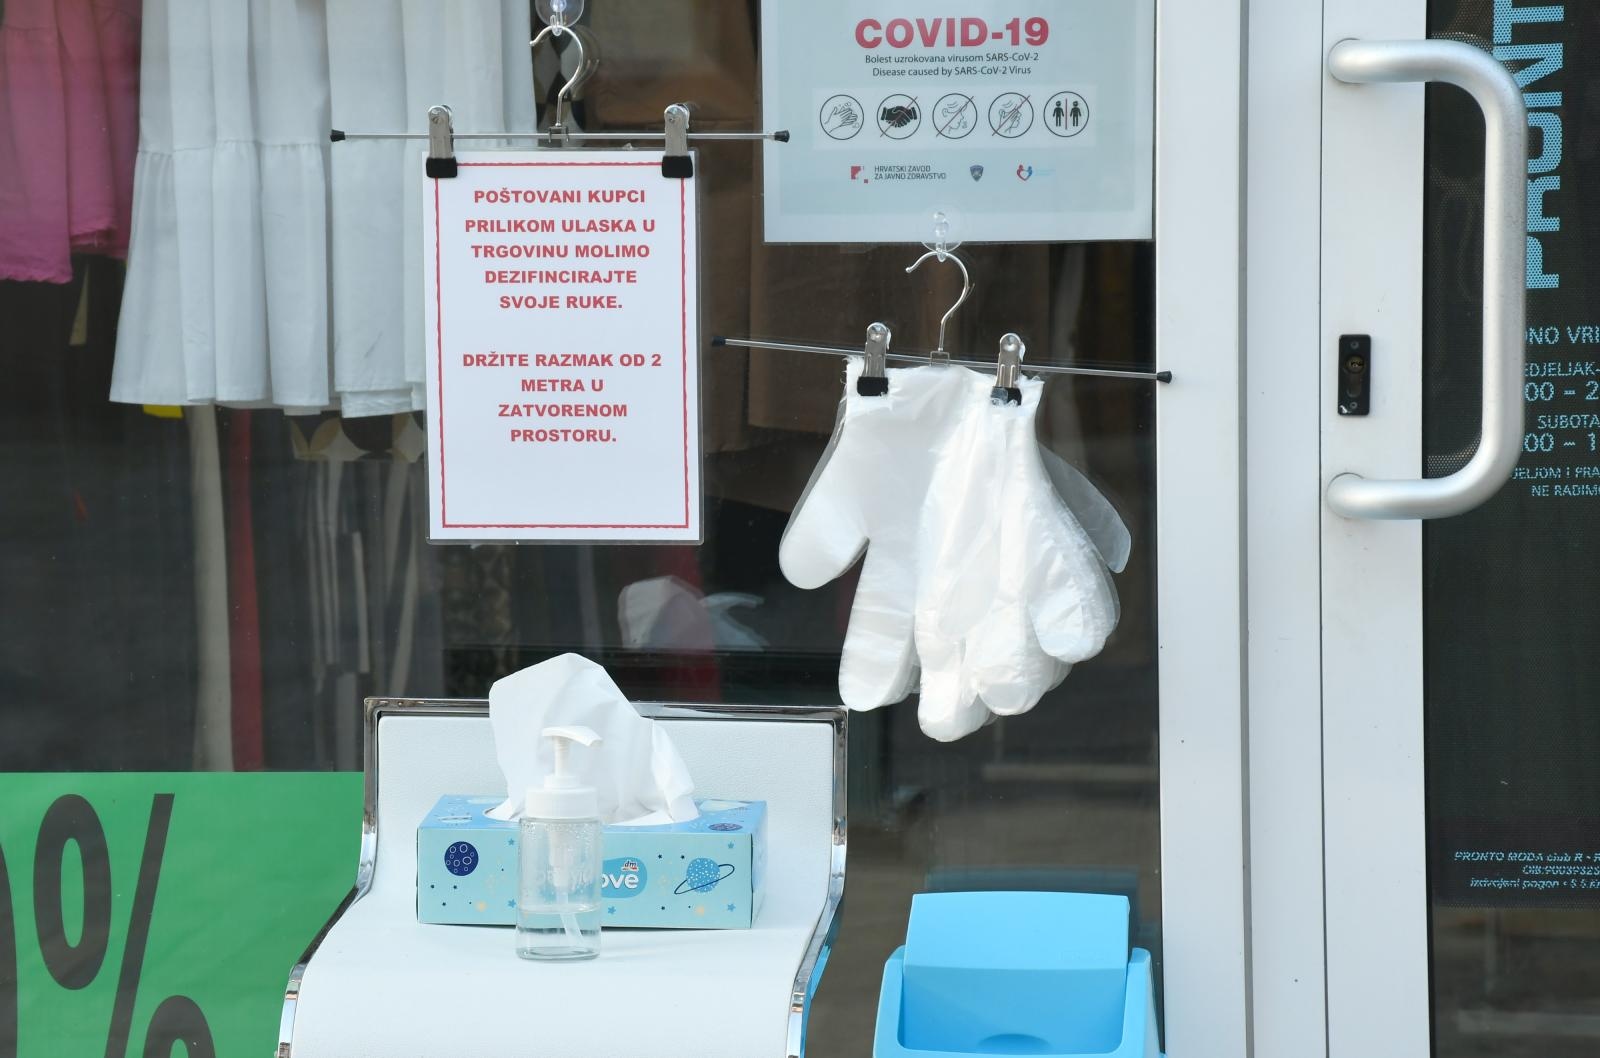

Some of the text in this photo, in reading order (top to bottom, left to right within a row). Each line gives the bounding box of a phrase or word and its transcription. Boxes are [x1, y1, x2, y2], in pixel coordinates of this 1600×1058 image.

[855, 17, 1049, 49] COVID-19
[865, 52, 1040, 64] Bolest uzrokovana virusom SARS-CoV-2
[872, 65, 1032, 78] Disease caused by SARS-CoV-2 Virus
[874, 165, 907, 173] HRVATSKI
[874, 172, 947, 180] ZA JAVNO ZDRAVSTVO
[473, 187, 646, 204] POŠTOVANI KUPCI
[465, 219, 656, 233] PRILIKOM ULASKA U
[471, 244, 650, 258] TRGOVINU MOLIMO
[484, 270, 637, 284] DEZIFINCIRAJTE
[499, 295, 623, 309] SVOJE RUKE.
[462, 351, 662, 367] DRŽITE RAZMAK OD 2
[520, 379, 605, 393] METRA U
[498, 404, 628, 418] ZATVORENOM
[1537, 414, 1600, 429] SUBOTA
[510, 429, 618, 443] PROSTORU.
[1531, 484, 1550, 497] NE
